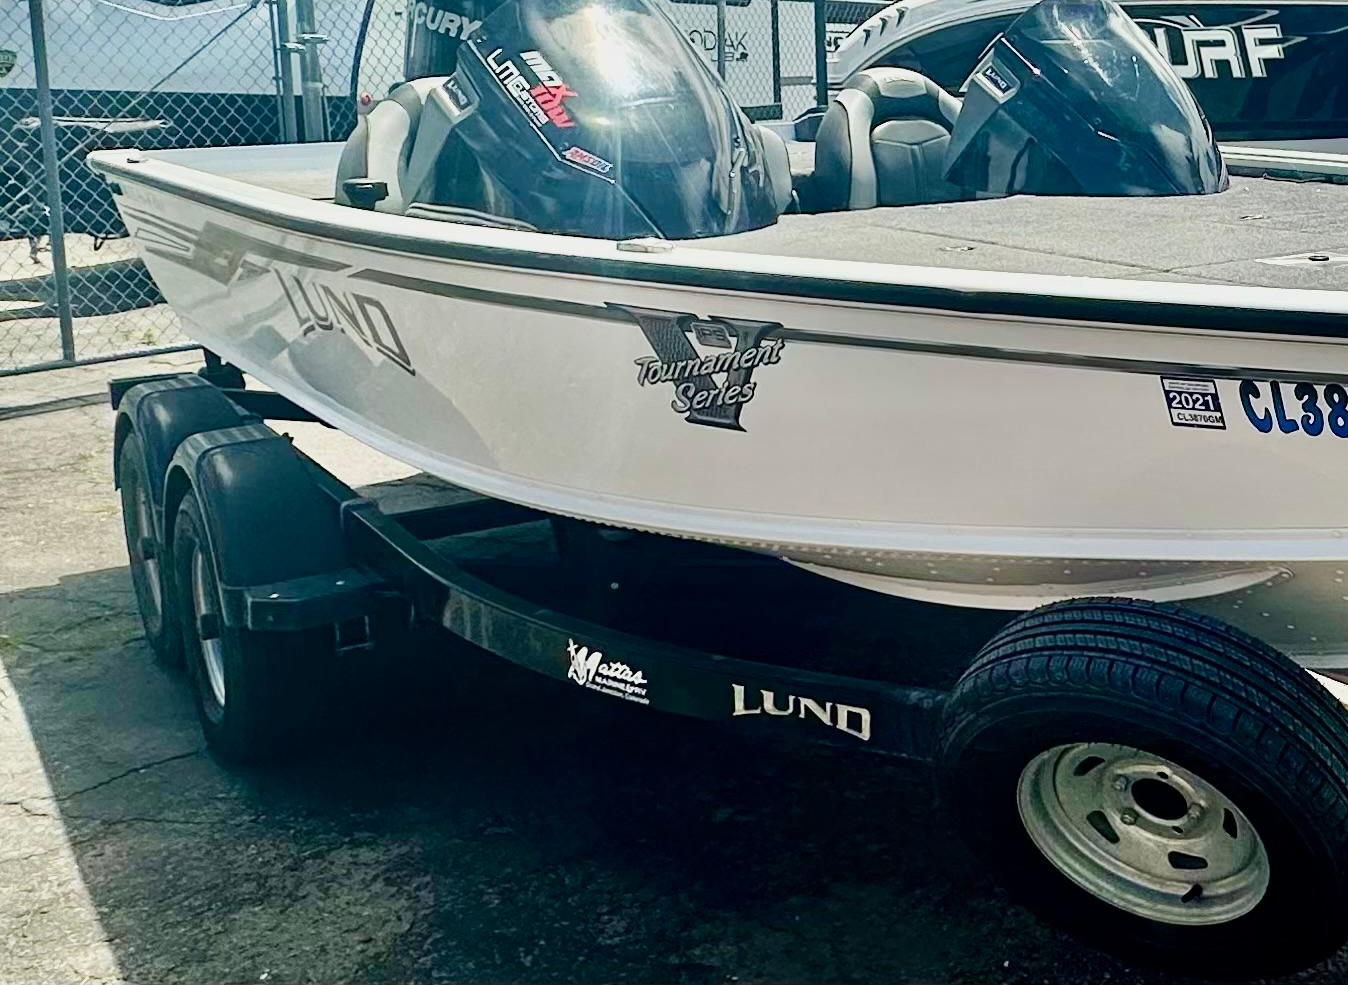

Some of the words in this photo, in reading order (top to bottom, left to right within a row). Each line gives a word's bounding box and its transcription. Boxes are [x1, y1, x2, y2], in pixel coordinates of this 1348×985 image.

[1153, 24, 1285, 79] URF
[274, 268, 416, 376] LUND
[633, 337, 786, 387] Tournament
[671, 379, 758, 414] Series
[1169, 392, 1215, 410] 2021
[567, 646, 648, 685] Mattas
[731, 683, 871, 741] LUND
